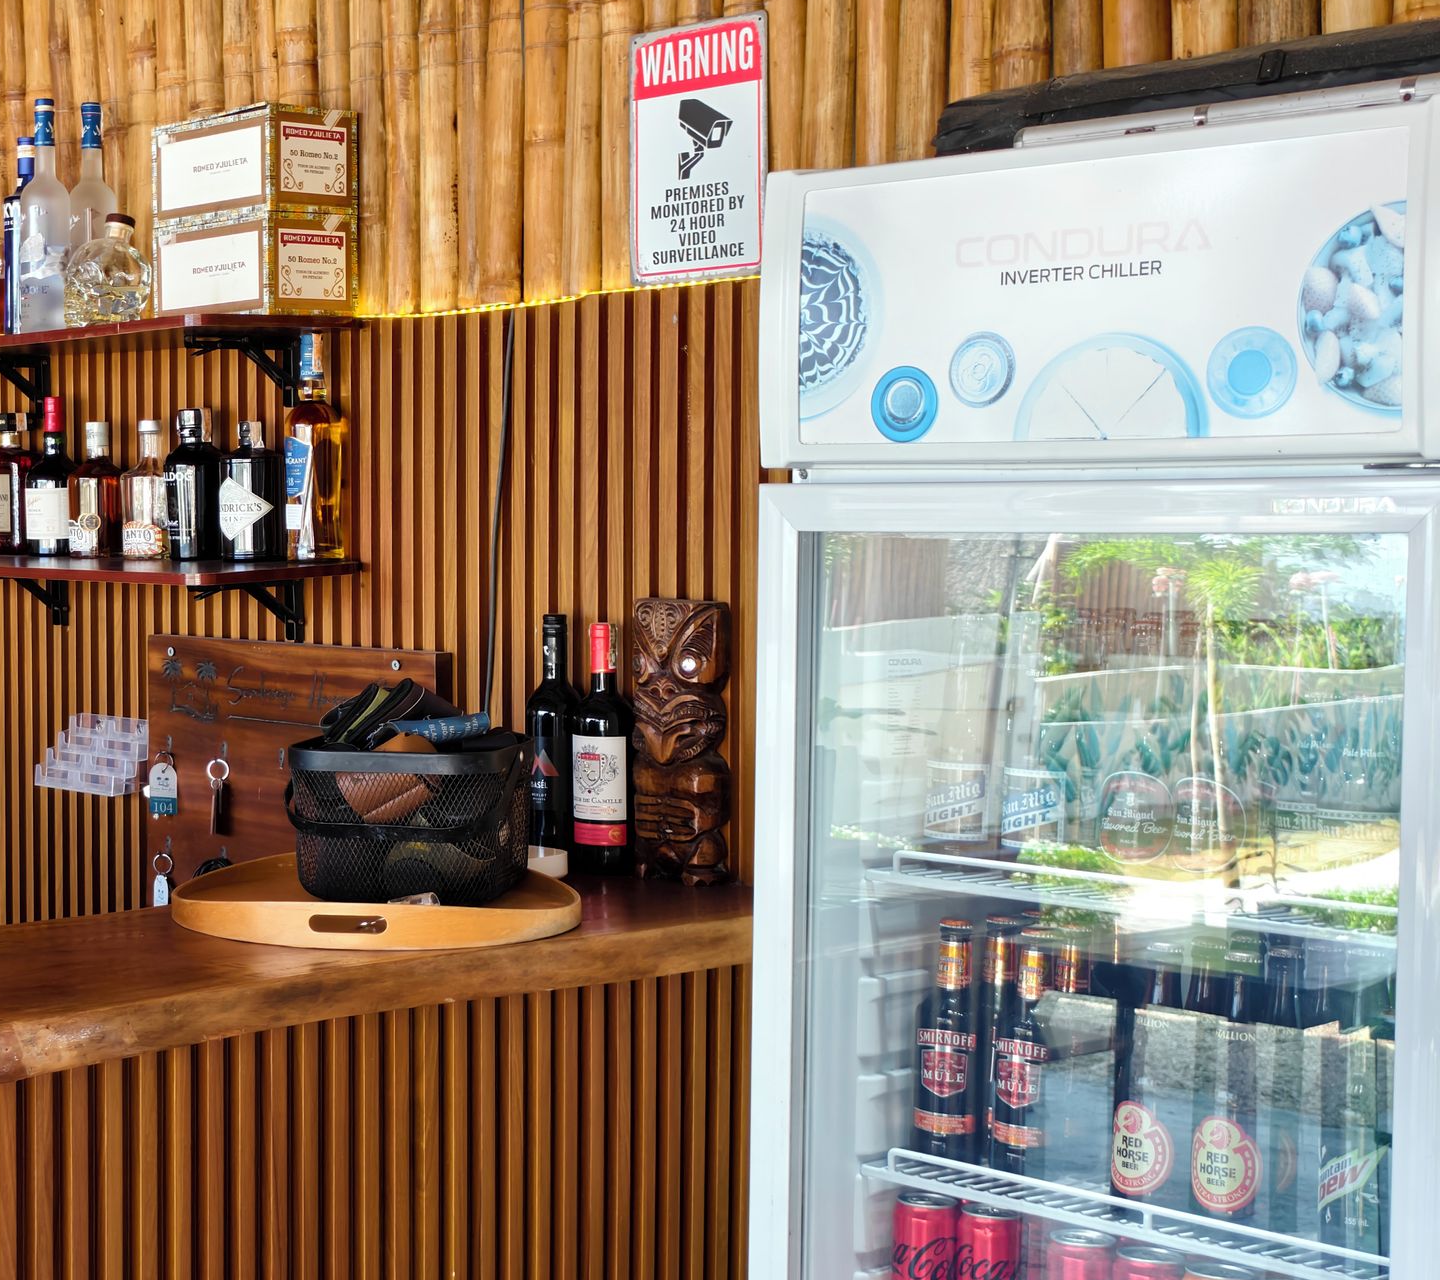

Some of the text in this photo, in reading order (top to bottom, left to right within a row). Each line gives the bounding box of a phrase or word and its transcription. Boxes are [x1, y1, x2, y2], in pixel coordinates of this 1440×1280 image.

[641, 26, 754, 87] WARNING
[299, 150, 322, 159] Romeo
[665, 181, 729, 203] PREMISES
[651, 195, 745, 220] MONITORED BY
[670, 213, 725, 233] 24 HOUR
[678, 229, 717, 247] VIDEO
[955, 218, 1212, 268] CONDURA
[298, 256, 321, 264] Romeo
[652, 242, 745, 265] SURVEILLANCE
[1000, 260, 1162, 286] INVERTER CHILLER
[153, 800, 174, 814] 104
[920, 1031, 973, 1047] SMIRNOFF
[995, 1040, 1047, 1059] SMIRNOFF
[923, 1069, 964, 1082] MULE
[997, 1079, 1036, 1094] MULE
[1122, 1135, 1142, 1148] RED
[1116, 1145, 1149, 1163] HORSE
[1206, 1151, 1229, 1164] RED
[1122, 1161, 1139, 1171] BEER
[1200, 1163, 1236, 1179] HORSE
[1123, 1172, 1156, 1187] STRONG
[1206, 1177, 1226, 1187] BEER
[1212, 1187, 1247, 1203] STRONG
